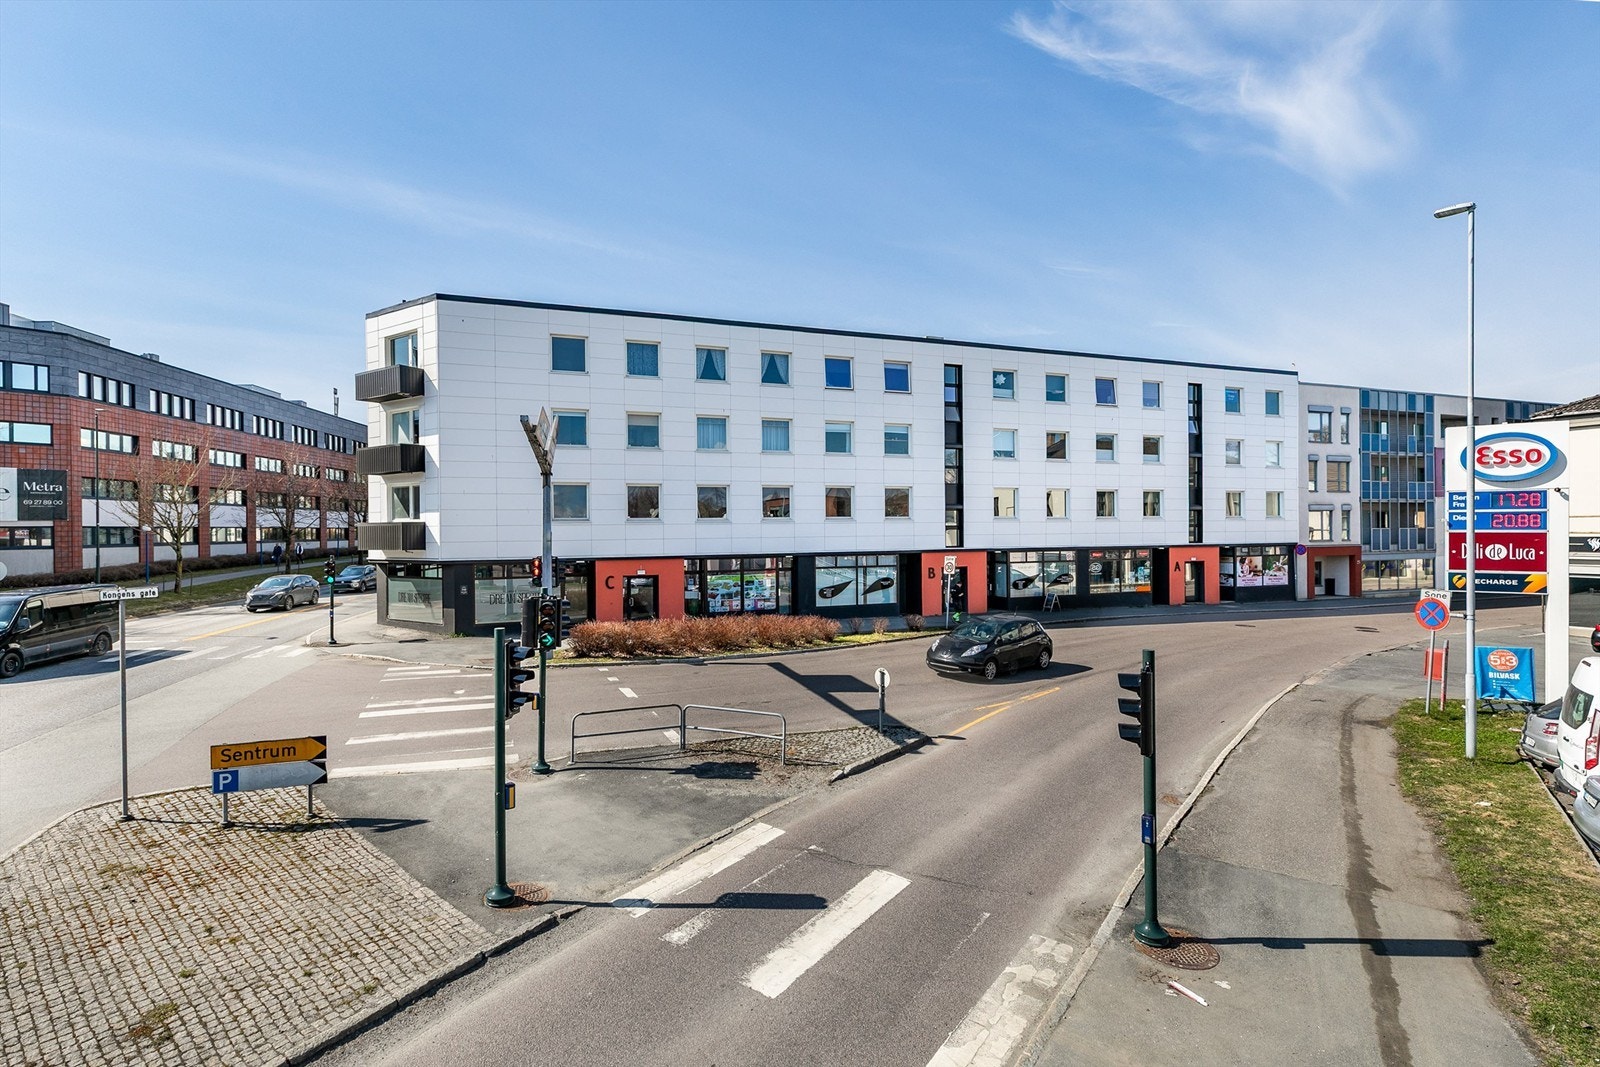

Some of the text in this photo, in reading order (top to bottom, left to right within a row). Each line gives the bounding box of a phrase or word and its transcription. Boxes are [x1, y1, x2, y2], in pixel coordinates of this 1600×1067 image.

[1476, 446, 1543, 466] Esso
[23, 481, 63, 491] Metra
[1499, 493, 1540, 506] 17.28
[1492, 514, 1540, 527] 20.88
[1461, 543, 1536, 560] Dli de Luca
[1174, 561, 1181, 572] A
[927, 567, 936, 579] B
[605, 575, 615, 590] C
[1475, 578, 1518, 586] ECHARGE
[102, 588, 157, 600] Kongens gate
[1424, 590, 1448, 600] Sone
[1490, 655, 1501, 666] 5
[1505, 655, 1517, 666] 3
[1488, 672, 1520, 680] BILVASK
[220, 746, 296, 762] Sentrum
[219, 773, 232, 791] P
